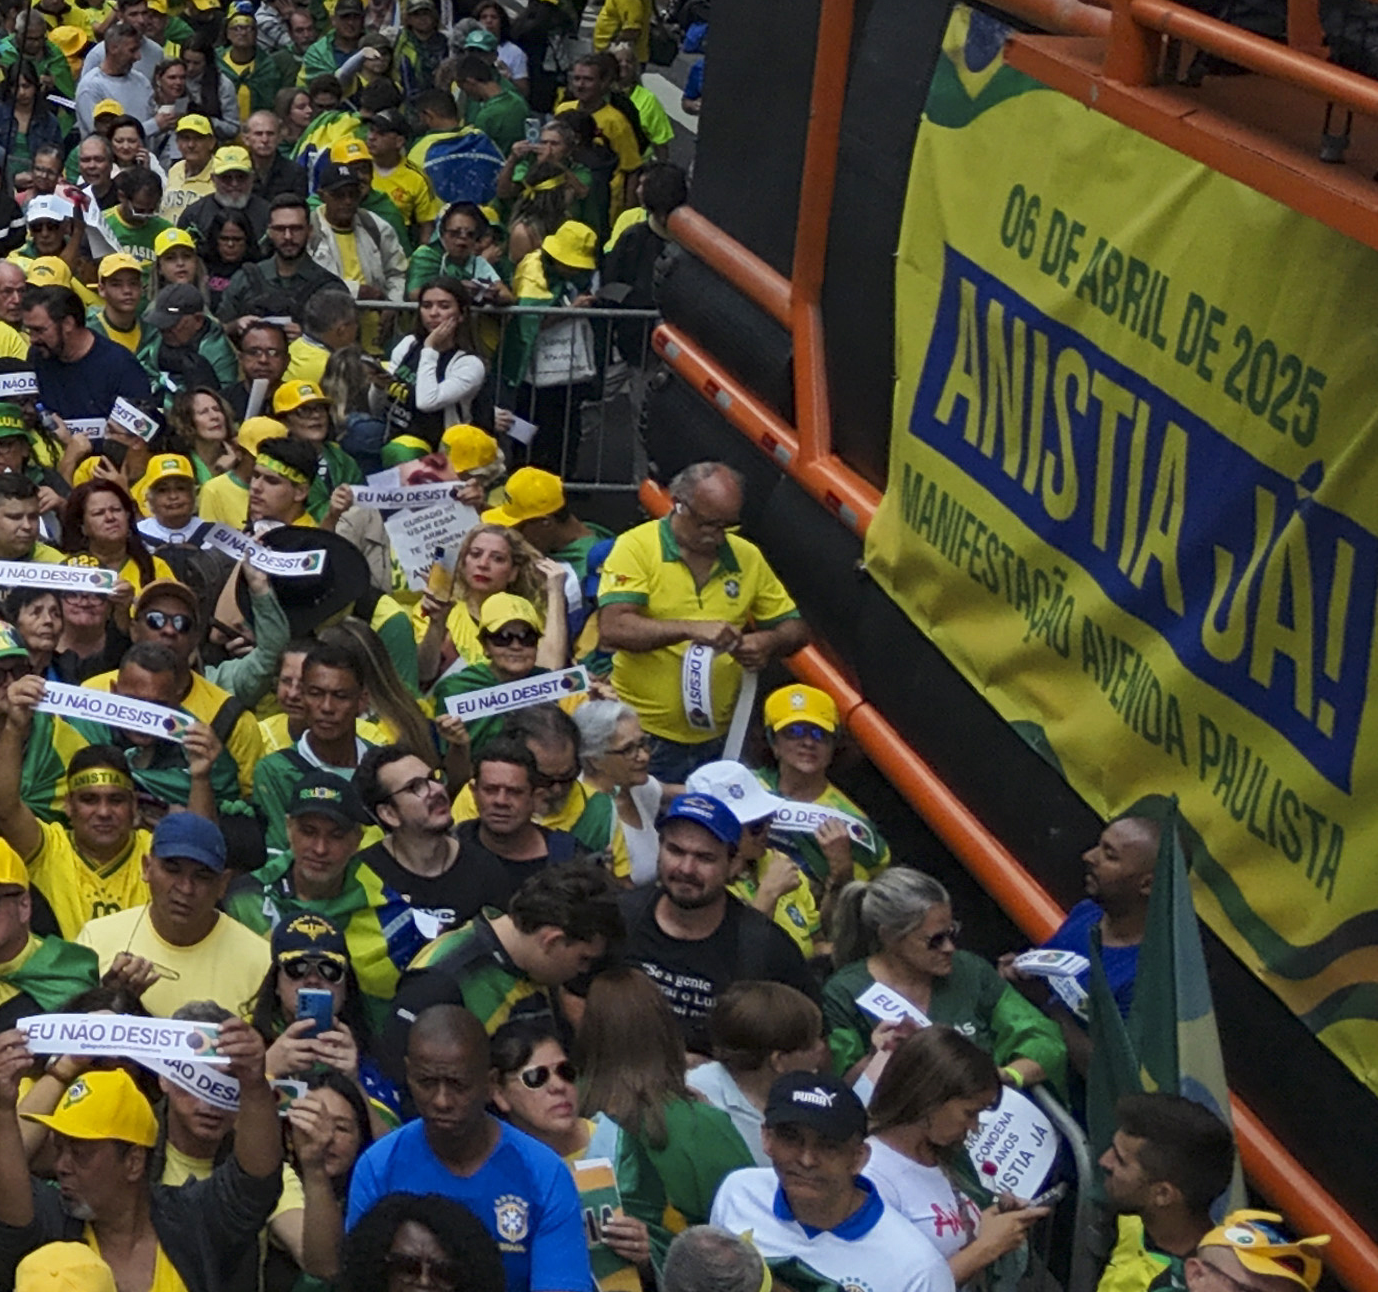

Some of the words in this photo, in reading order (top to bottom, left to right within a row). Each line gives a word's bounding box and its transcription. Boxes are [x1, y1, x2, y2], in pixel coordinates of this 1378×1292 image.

[1000, 183, 1038, 259] 06
[1038, 206, 1087, 289] DE
[1075, 236, 1169, 351] ABRIL
[1174, 290, 1224, 385] DE
[1222, 324, 1328, 448] 2025
[356, 491, 373, 502] EU
[376, 489, 403, 503] NÃO
[934, 275, 1188, 618] ANISTIA
[1201, 460, 1354, 740] JÁ!
[214, 528, 230, 545] EU
[230, 537, 256, 558] NÃO
[7, 565, 38, 580] NÃO
[900, 461, 1072, 658] MANIFESTAÇÃO
[1081, 629, 1188, 769] AVENIDA
[1199, 714, 1344, 904] PAULISTA
[42, 690, 64, 705] EU
[65, 694, 102, 712] NÃO
[456, 699, 476, 715] EU
[479, 689, 509, 708] NÃO
[74, 772, 122, 786] ANISTIA
[873, 993, 897, 1019] EU
[27, 1022, 56, 1040] EU
[60, 1020, 105, 1041] NÃO
